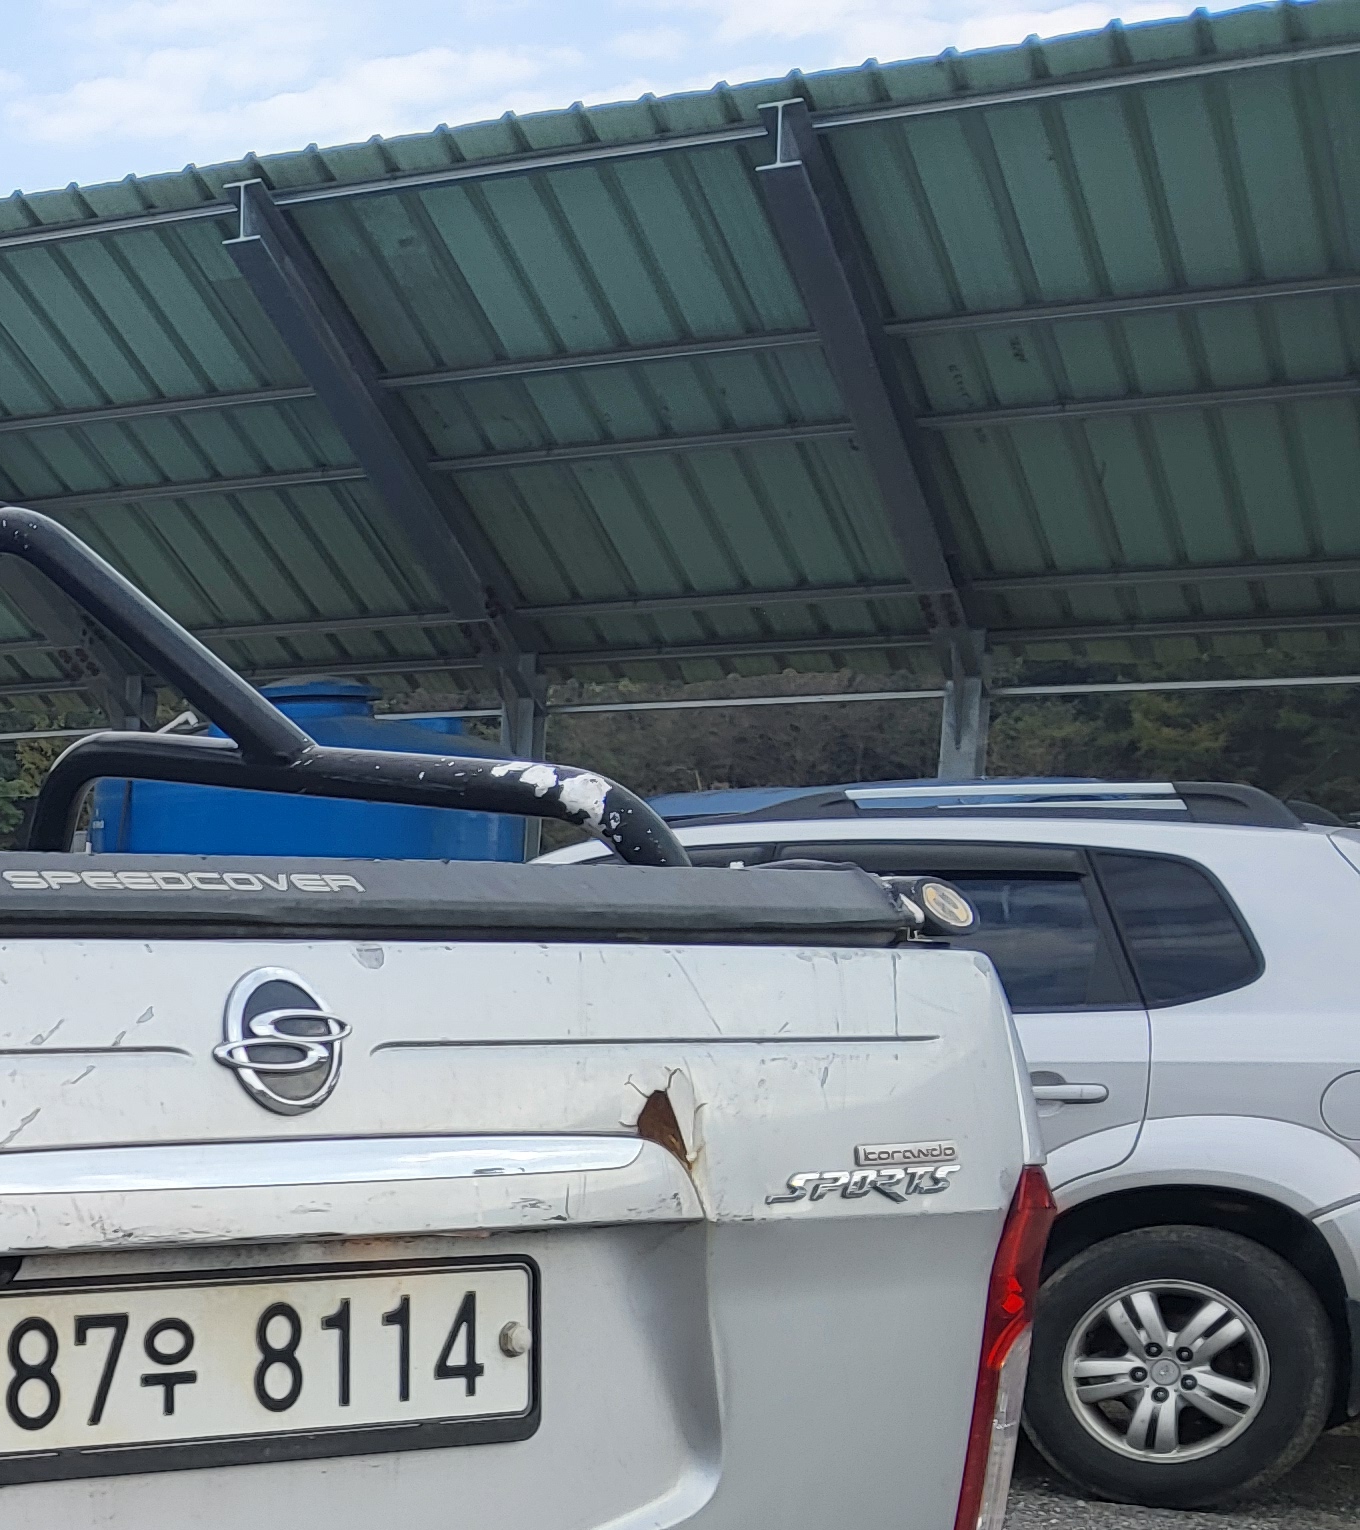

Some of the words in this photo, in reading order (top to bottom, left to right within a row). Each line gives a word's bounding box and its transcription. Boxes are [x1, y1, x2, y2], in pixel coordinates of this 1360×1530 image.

[1, 869, 367, 893] SPEEDCOVER
[764, 1164, 962, 1205] SPORTS
[5, 1312, 198, 1431] 87우
[253, 1290, 485, 1413] 8114
